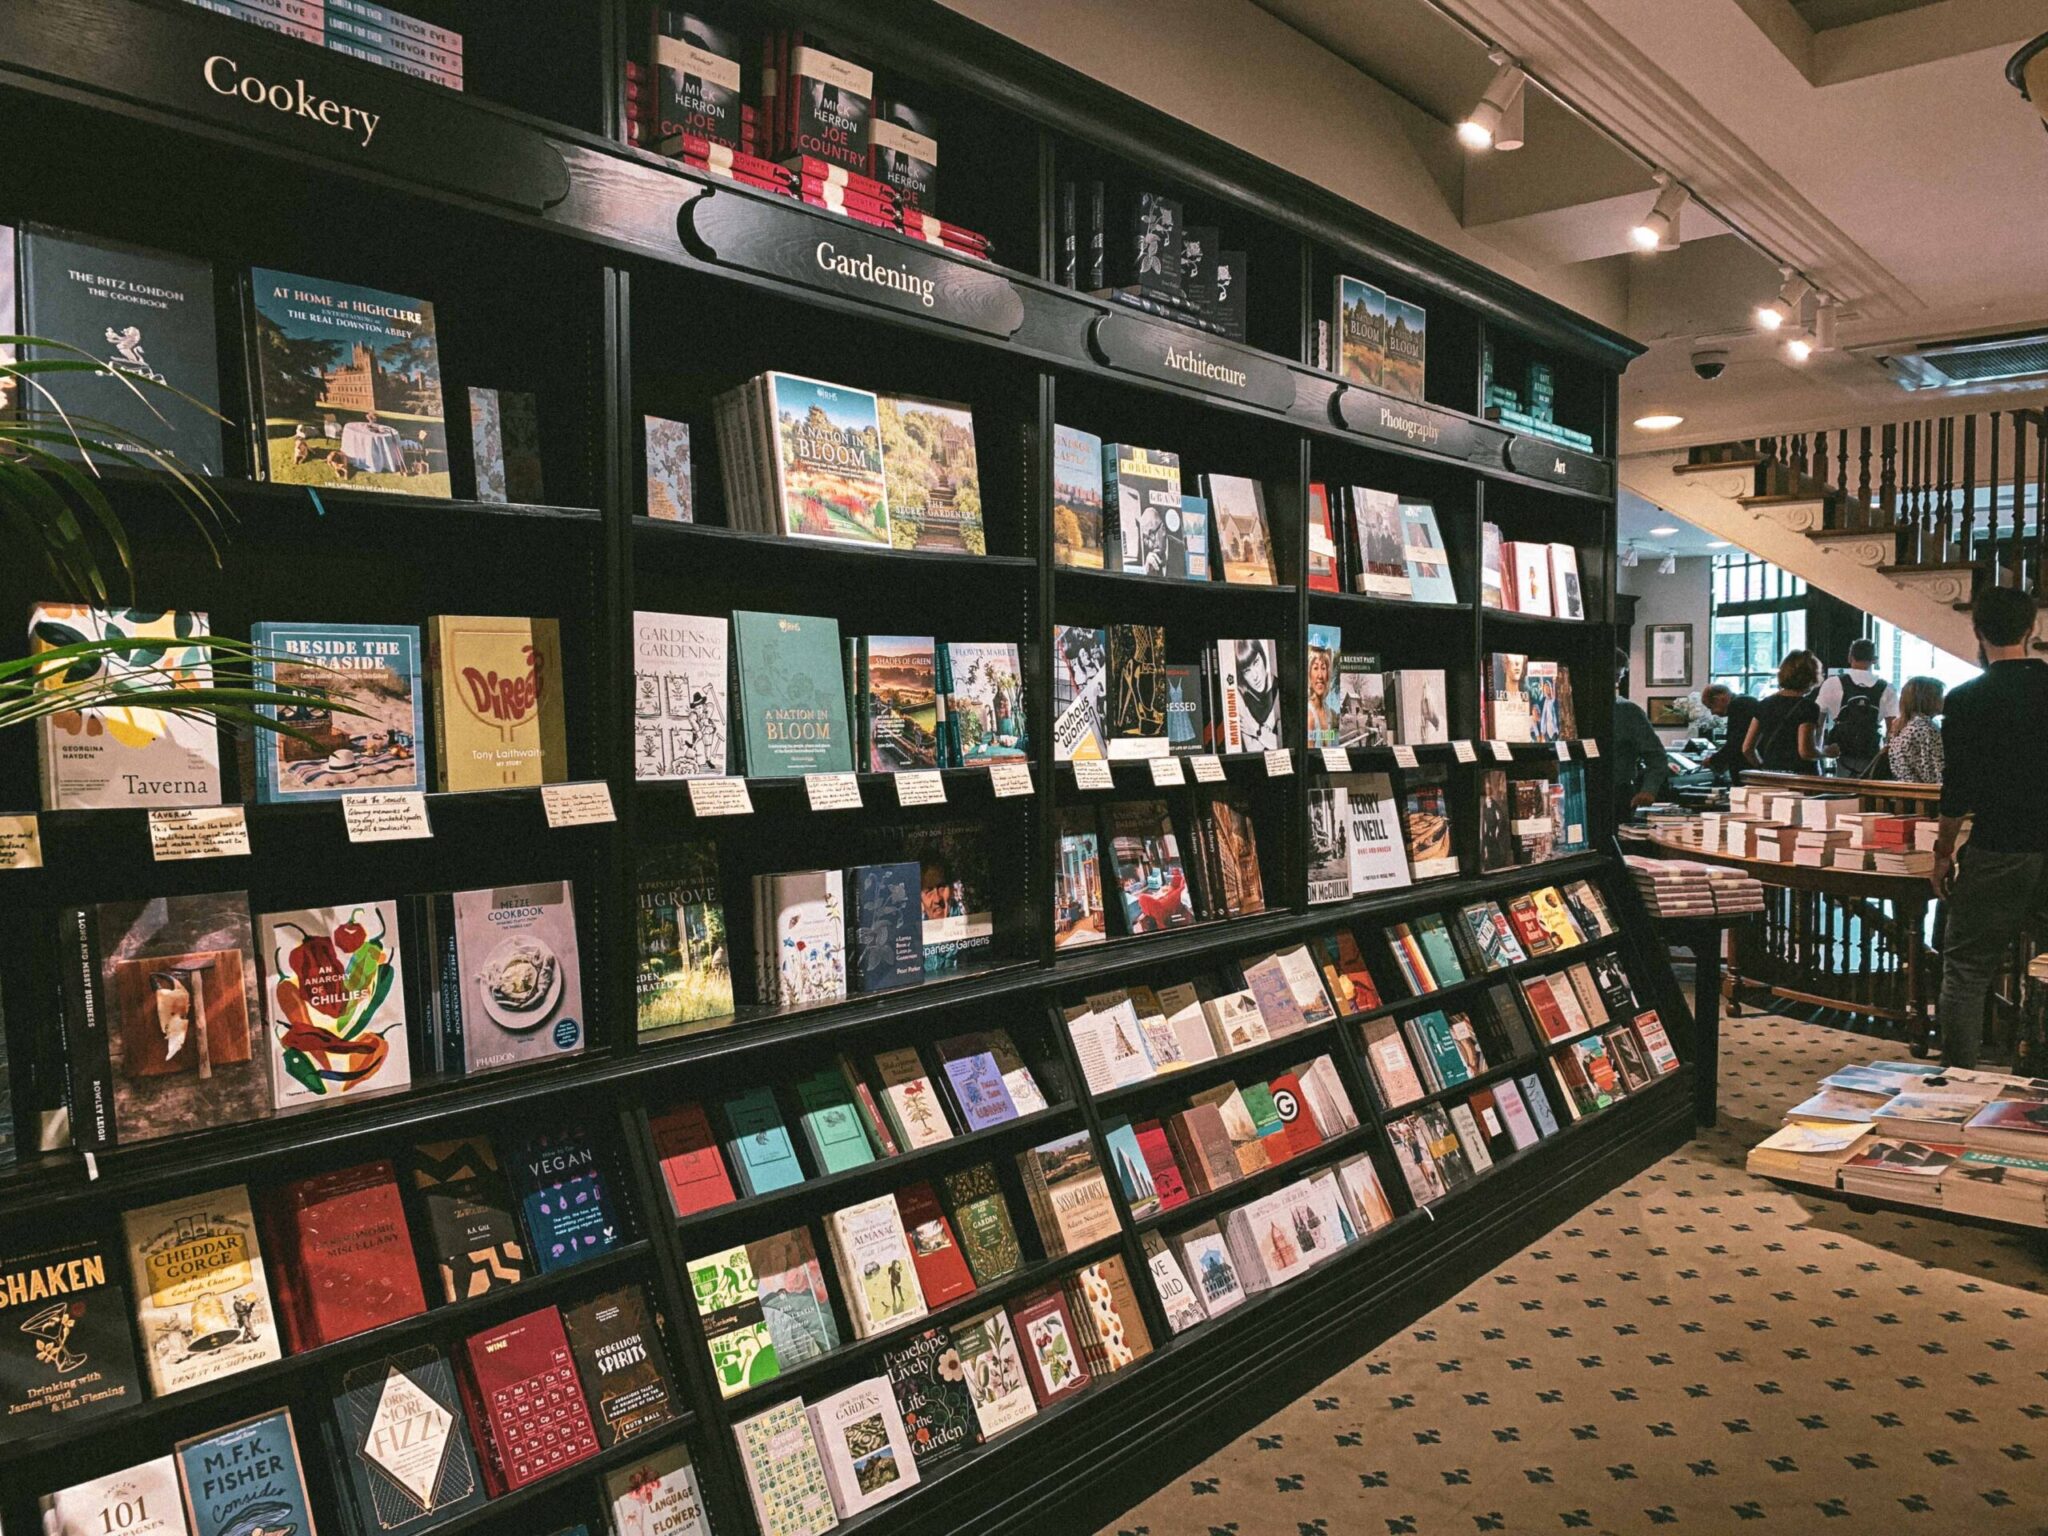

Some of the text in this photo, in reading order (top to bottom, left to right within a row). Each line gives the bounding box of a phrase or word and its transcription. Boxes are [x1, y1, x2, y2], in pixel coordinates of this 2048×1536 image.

[286, 4, 306, 18] EVE
[390, 17, 447, 44] TREVOR EVE
[390, 38, 447, 65] TREVOR EVE
[390, 60, 426, 79] TREVOR
[204, 55, 380, 147] Cookery
[685, 81, 716, 102] MICK
[675, 93, 725, 119] HERRON
[823, 97, 851, 118] MICK
[685, 111, 716, 132] JOE
[814, 109, 857, 134] HERRON
[821, 126, 848, 145] JOE
[801, 134, 866, 168] COUNTRY
[896, 161, 920, 179] MICK
[887, 171, 926, 193] HERRON
[816, 242, 935, 307] Gardening
[68, 270, 184, 302] THE RITZ LONDON
[88, 287, 168, 310] THE COOKBOOK
[273, 287, 422, 324] AT HOME at HIGHCLERE
[287, 310, 412, 339] THE REAL DOWNTON ABBEY
[1351, 320, 1379, 342] BLOOM
[1390, 337, 1419, 358] BLOOM
[1164, 346, 1247, 388] Architecture
[797, 425, 864, 447] A NATION IN
[1380, 407, 1440, 443] Photography
[798, 438, 867, 468] BLOOM
[1554, 457, 1566, 475] Art
[926, 500, 944, 510] THE
[1149, 490, 1182, 506] GRAND
[639, 627, 704, 644] GARDENS
[285, 640, 400, 656] BESIDE THE
[639, 643, 721, 661] GARDENING
[955, 648, 1015, 657] FLOWER MARKET
[303, 656, 385, 670] SEASIDE
[875, 657, 932, 665] SHADES OF GREEN
[765, 710, 828, 720] A NATION IN
[1054, 695, 1090, 743] bauhaus
[1226, 687, 1239, 746] MARY QUANT
[767, 722, 831, 740] BLOOM
[472, 748, 545, 761] Tony Laithwaite
[122, 774, 208, 794] Taverna
[1351, 793, 1380, 815] TERRY
[1353, 821, 1388, 842] O'NEILL
[1319, 880, 1349, 900] McCULLIN
[488, 907, 544, 921] COOKBOOK
[500, 898, 530, 909] MEZZE
[78, 918, 87, 941] LONG
[81, 943, 89, 960] AND
[956, 936, 990, 950] Gardens
[82, 960, 92, 988] MESSY
[305, 973, 351, 986] ANARCHY
[319, 966, 332, 974] AN
[85, 988, 95, 1029] BUSINESS
[311, 989, 369, 1006] CHILLIES
[476, 1052, 515, 1067] PHAIDON
[1277, 1094, 1295, 1120] G
[98, 1114, 106, 1142] LEIGH
[529, 1149, 592, 1176] VEGAN
[973, 1215, 998, 1229] GARDEN
[1067, 1218, 1083, 1229] Adam
[327, 1234, 400, 1258] MISCELLANY
[854, 1225, 894, 1246] ALMANAC
[154, 1236, 239, 1267] CHEDDAR
[167, 1251, 233, 1278] GORGE
[486, 1341, 508, 1353] WINE
[595, 1333, 642, 1358] REBELLIOUS
[884, 1334, 947, 1368] Penelope
[171, 1351, 266, 1386] ERNEST SHEPARD
[598, 1343, 647, 1375] SPIRITS
[887, 1357, 931, 1384] Lively
[27, 1372, 101, 1398] Drinking with
[641, 1384, 654, 1394] TALES
[650, 1388, 659, 1396] THE
[655, 1391, 665, 1400] LAW
[8, 1390, 71, 1415] James Bond
[51, 1385, 125, 1412] & Ian Fleming
[384, 1390, 417, 1409] DRINK
[836, 1396, 880, 1422] GARDENS
[899, 1393, 928, 1416] Life
[381, 1399, 425, 1424] MORE
[625, 1412, 661, 1430] RUTH BALL
[373, 1409, 445, 1458] FIZZ!
[905, 1413, 933, 1433] in the
[912, 1423, 964, 1456] Garden
[204, 1438, 271, 1474] M.F.K.
[203, 1456, 284, 1500] FISHER
[648, 1486, 694, 1514] LANGUAGE
[99, 1496, 150, 1534] 101
[653, 1504, 702, 1536] FLOWERS
